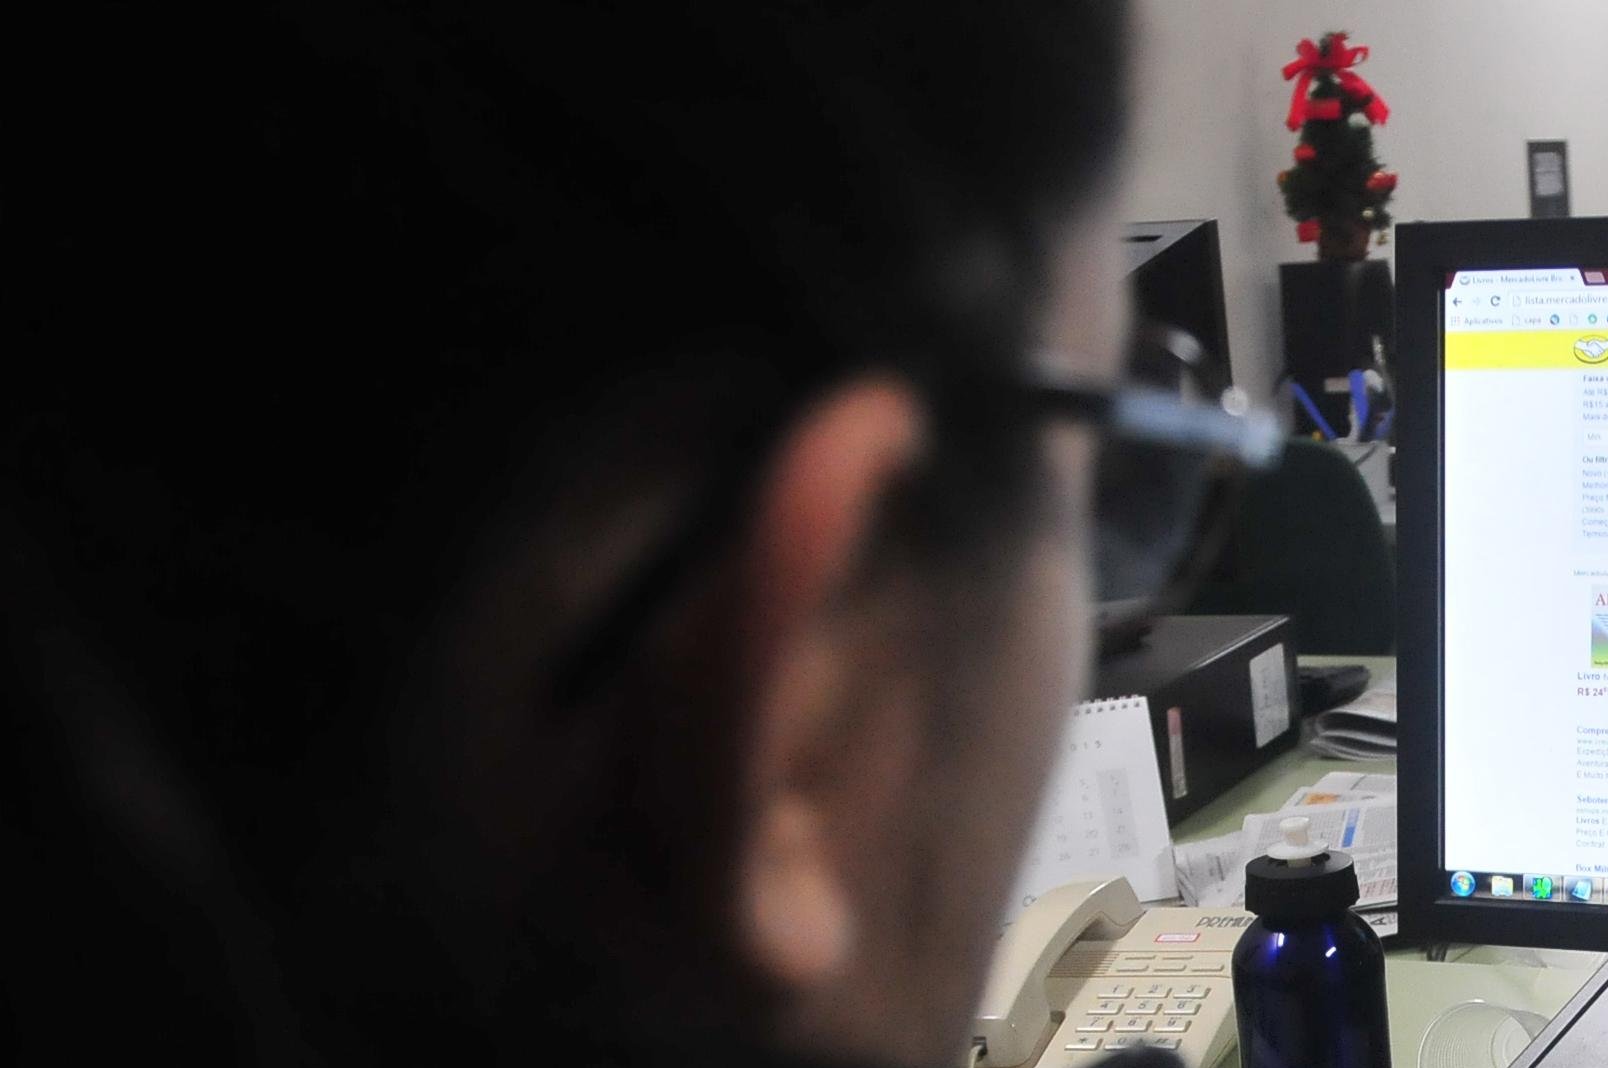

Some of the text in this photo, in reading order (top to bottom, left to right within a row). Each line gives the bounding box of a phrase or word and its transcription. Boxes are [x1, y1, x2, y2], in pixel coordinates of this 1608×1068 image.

[1577, 671, 1601, 681] Livro
[1577, 686, 1590, 697] R$
[1576, 816, 1600, 826] Livros
[1576, 863, 1592, 873] Box
